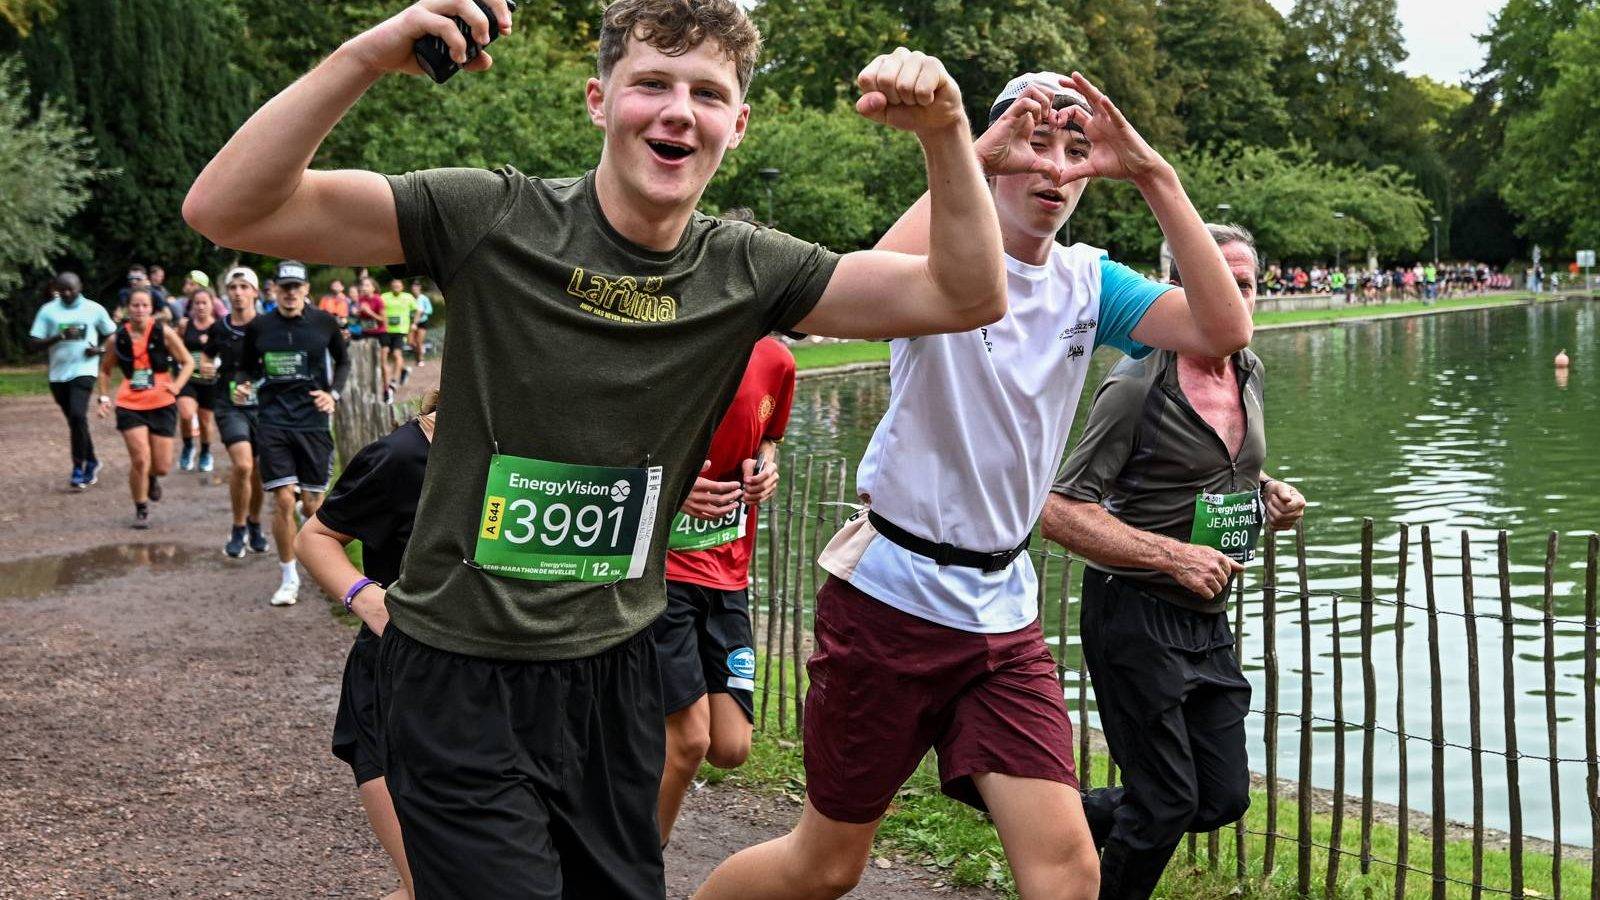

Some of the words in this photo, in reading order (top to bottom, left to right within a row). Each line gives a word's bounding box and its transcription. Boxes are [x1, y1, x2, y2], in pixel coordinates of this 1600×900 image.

[509, 473, 609, 496] EnergyVision
[488, 501, 500, 522] 644
[1207, 502, 1252, 515] EnergyVision
[486, 523, 496, 534] A
[504, 499, 625, 548] 3991
[1207, 514, 1258, 529] JEAN-PAUL
[1221, 529, 1249, 548] 660
[540, 561, 577, 569] EnergyVision
[547, 568, 576, 576] NIVELLES
[592, 562, 610, 577] 12
